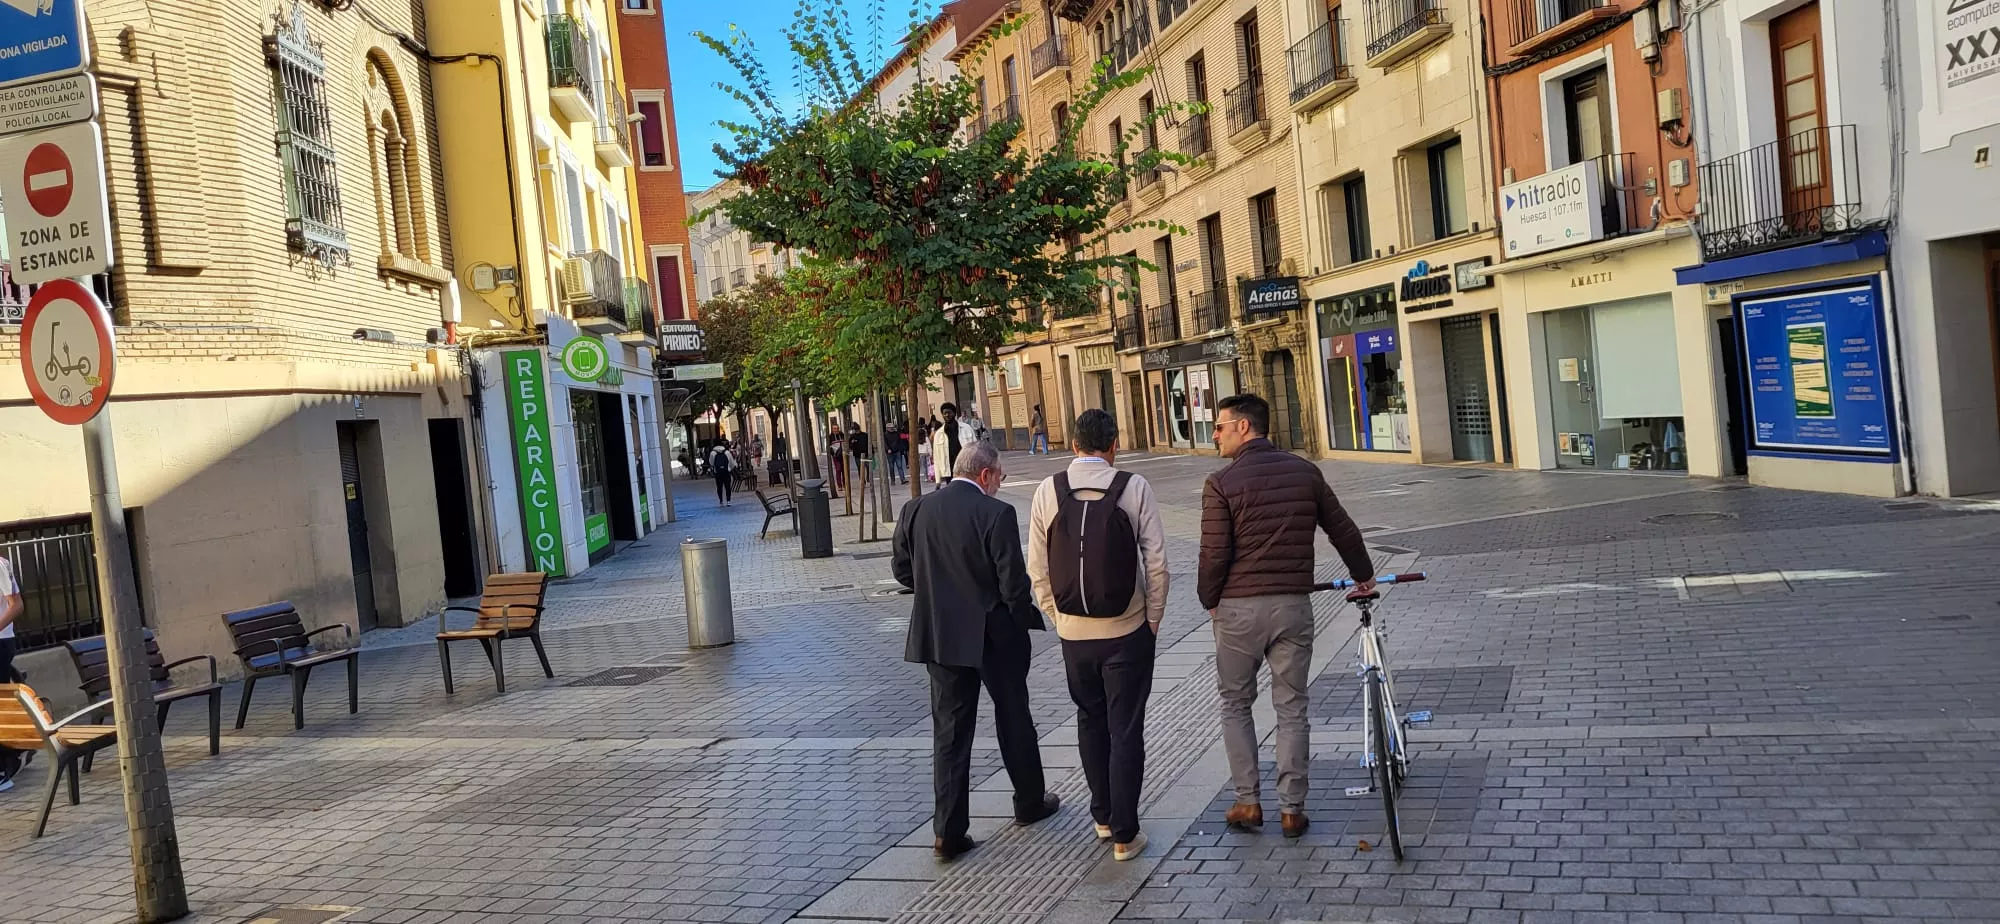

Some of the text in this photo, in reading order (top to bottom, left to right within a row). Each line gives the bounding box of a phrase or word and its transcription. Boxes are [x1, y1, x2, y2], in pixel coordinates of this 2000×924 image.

[22, 34, 68, 54] VIGILADA
[18, 80, 79, 98] CONTROLADA
[9, 91, 85, 111] VIDEOVIGILANCIA
[5, 110, 72, 128] POLICÍA LOCAL
[1518, 174, 1581, 209] hitradio
[1520, 211, 1547, 224] Huesca
[20, 221, 90, 247] ZONA DE
[20, 245, 95, 272] ESTANCIA
[1400, 274, 1452, 302] Arenas
[1570, 271, 1612, 288] AMATTI
[1248, 288, 1298, 304] Arenas
[661, 324, 697, 332] EDITORIAL
[663, 334, 700, 351] PIRINEO
[516, 358, 556, 573] REPARACION
